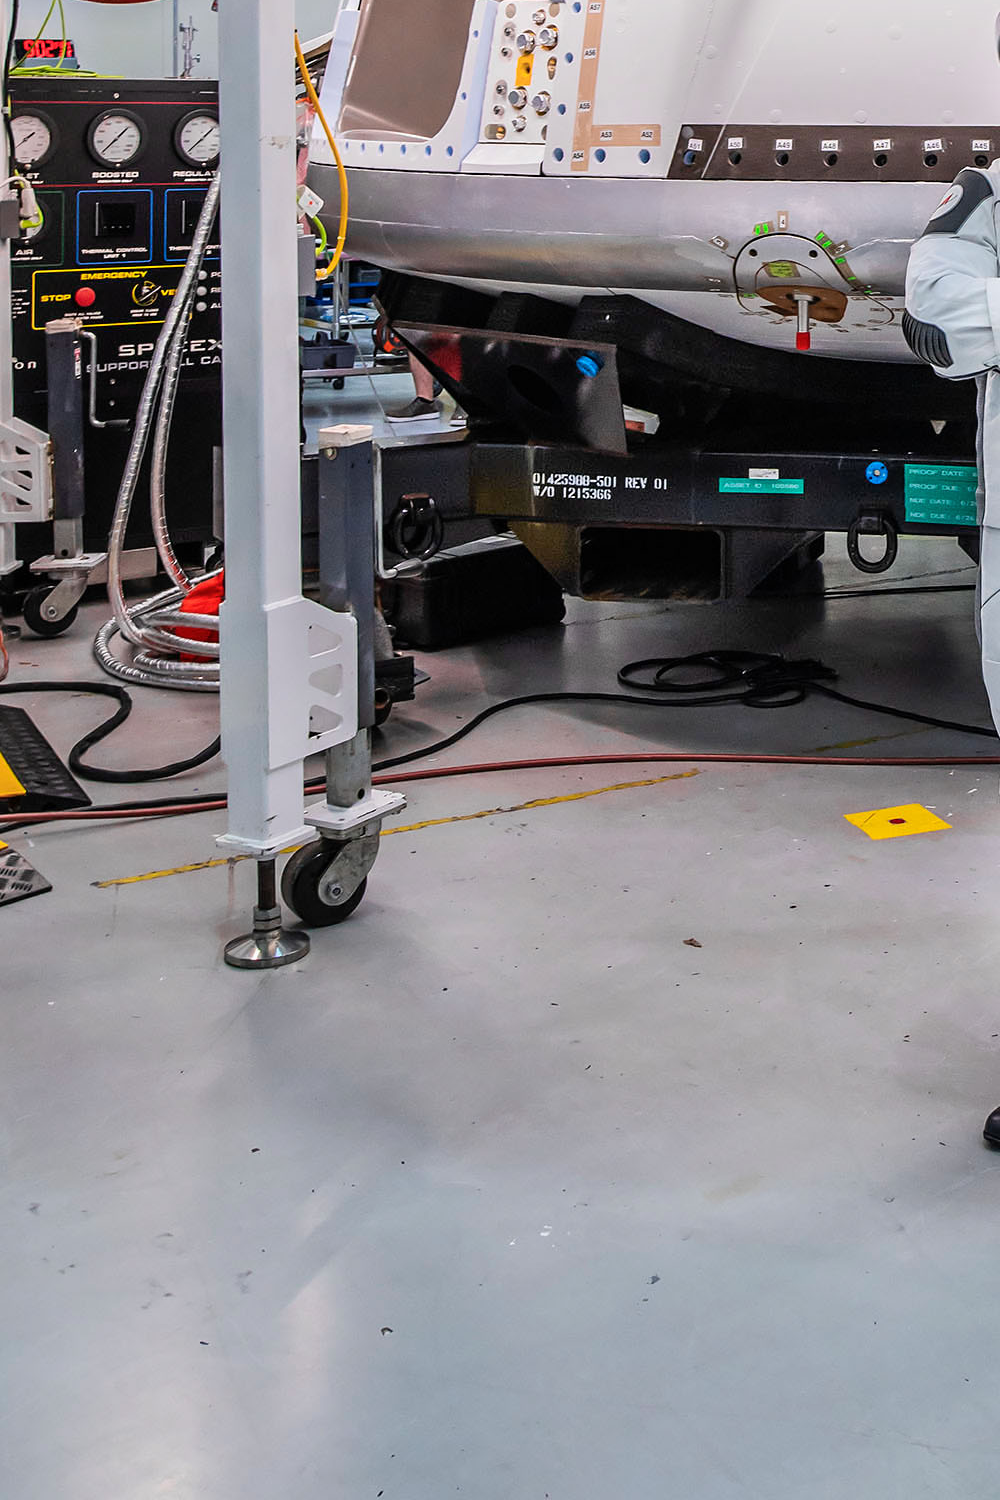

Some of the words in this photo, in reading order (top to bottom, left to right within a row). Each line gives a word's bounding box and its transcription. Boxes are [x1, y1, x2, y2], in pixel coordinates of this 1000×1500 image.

[589, 3, 601, 12] A57
[584, 49, 596, 57] A56
[579, 102, 590, 110] A55
[600, 131, 612, 139] A53
[777, 141, 791, 149] A49
[875, 142, 889, 150] A47
[926, 142, 941, 150] A46
[973, 142, 988, 150] A45
[92, 171, 139, 179] BOOSTED
[173, 171, 218, 179] REGULAT
[80, 271, 148, 281] EMERGENCY
[41, 294, 71, 302] STOP
[86, 360, 151, 373] SUPPOR
[625, 477, 647, 489] REV
[654, 478, 667, 490] 01
[533, 486, 554, 497] W/O
[563, 487, 612, 500] 1215366
